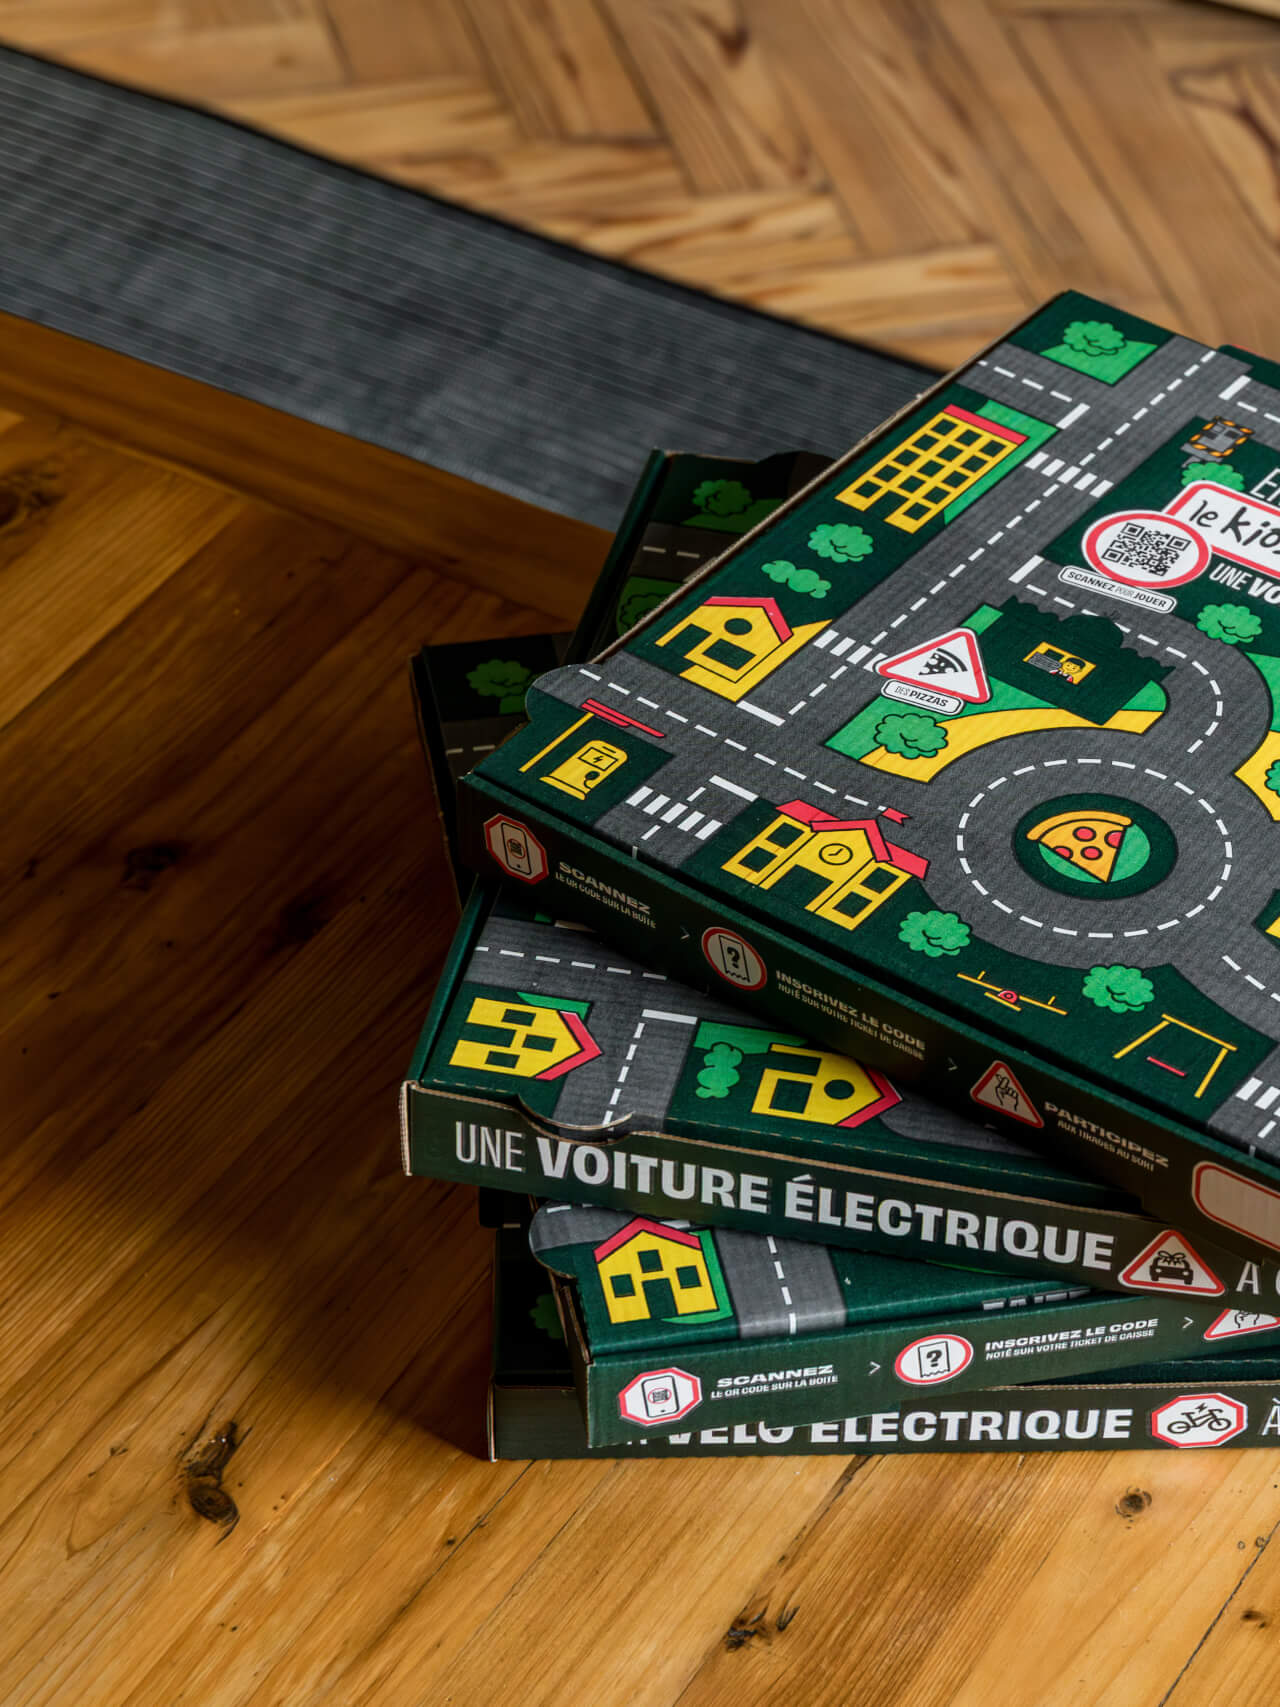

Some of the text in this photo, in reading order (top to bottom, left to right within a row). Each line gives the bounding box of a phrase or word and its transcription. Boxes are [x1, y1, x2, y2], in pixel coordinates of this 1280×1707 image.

[1189, 499, 1218, 527] le
[1067, 571, 1116, 593] SCANNEZ
[1134, 592, 1167, 608] JOUER
[1209, 562, 1252, 591] UNE
[894, 685, 949, 707] DES PIZZAS
[559, 861, 651, 916] SCANNEZ
[775, 969, 926, 1050] INSCRIVEZ LE CODE
[1044, 1101, 1169, 1169] PARTICIPEZ
[455, 1120, 524, 1173] UNE
[536, 1136, 770, 1214] VOITURE
[784, 1174, 1117, 1270] ÉLECTRIQUE
[985, 1318, 1159, 1352] INSCRIVEZ LE CODE
[986, 1328, 1156, 1361] NOTÉ SUR VOTRE TICKET DE CAISSE
[926, 1349, 943, 1368] ?
[711, 1390, 723, 1399] LE
[741, 1384, 769, 1395] CODE
[771, 1381, 793, 1391] SUR
[794, 1379, 808, 1388] LA
[717, 1364, 834, 1388] SCANNEZ
